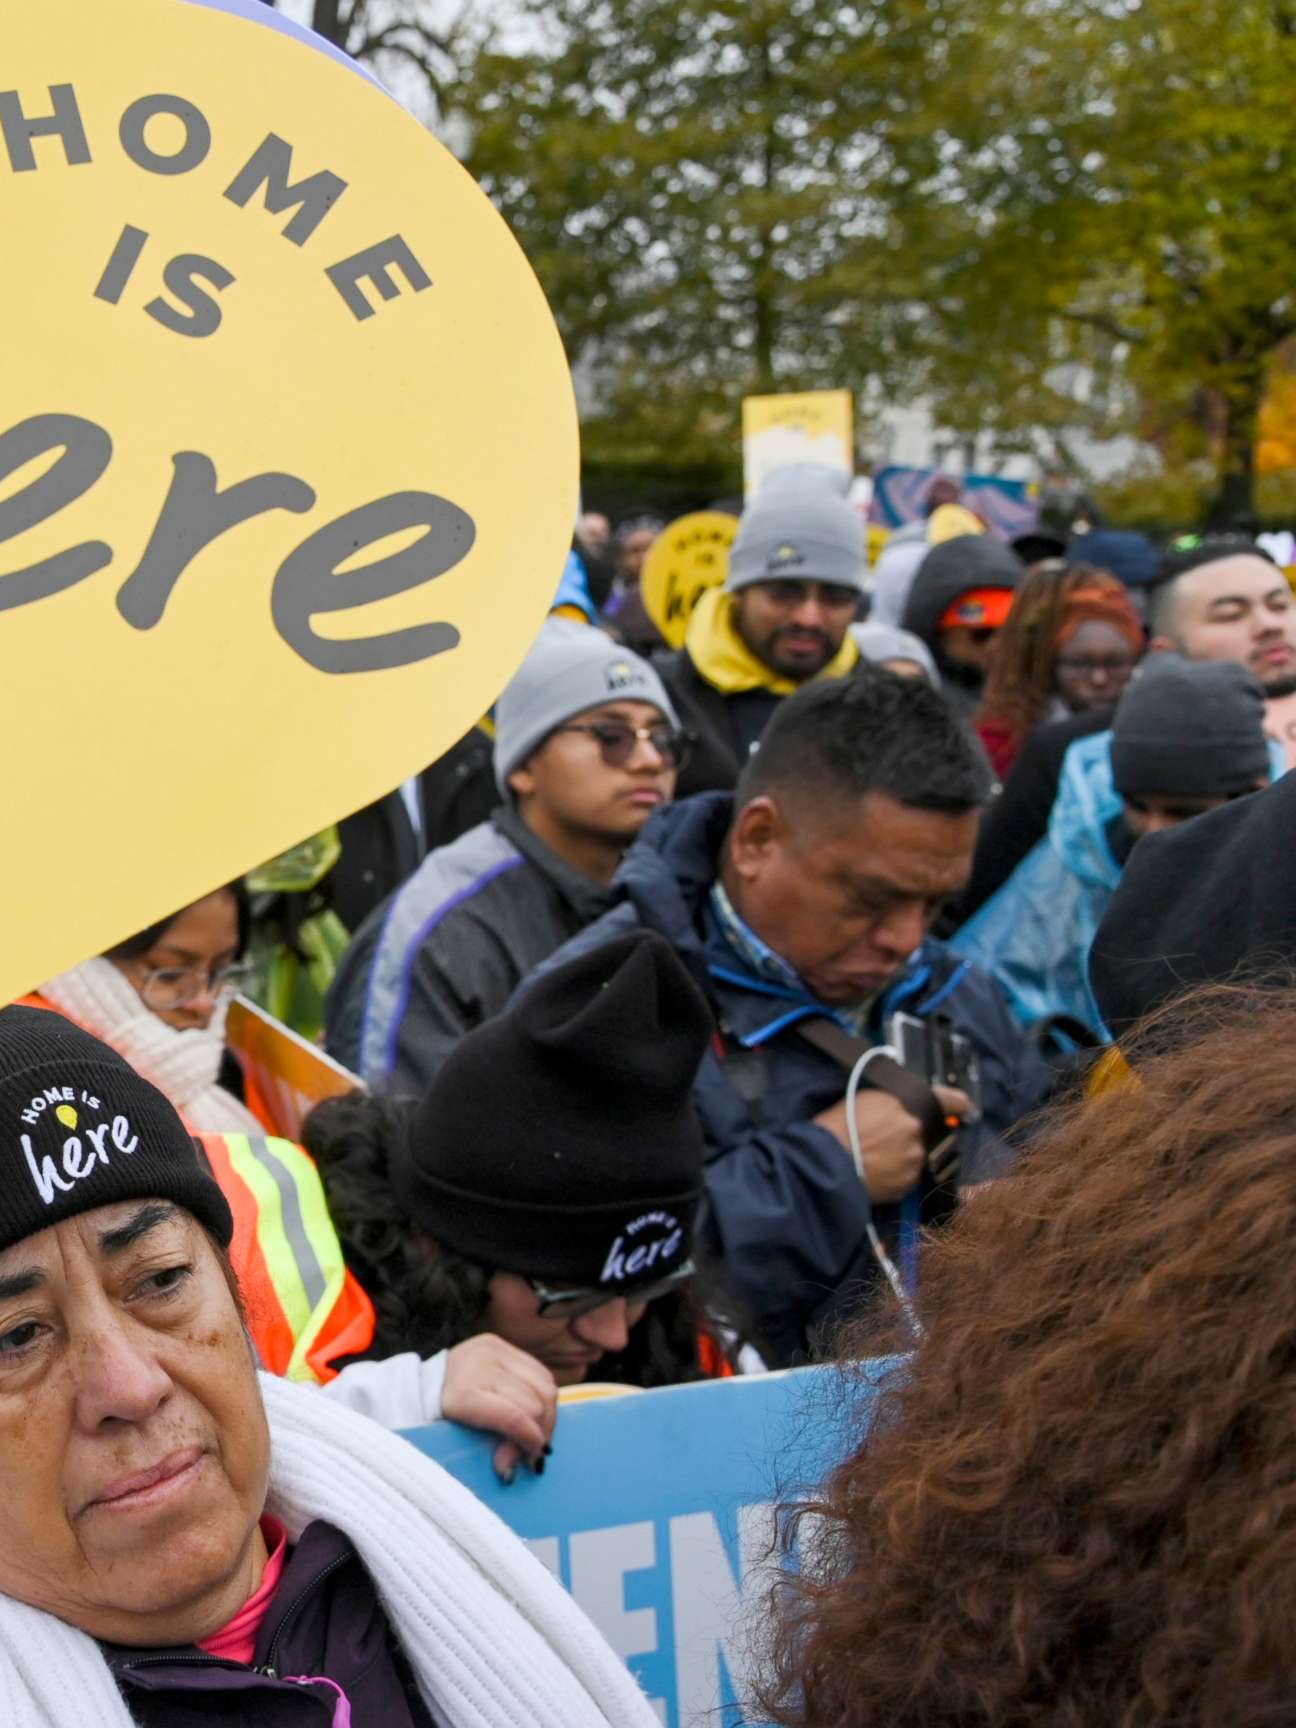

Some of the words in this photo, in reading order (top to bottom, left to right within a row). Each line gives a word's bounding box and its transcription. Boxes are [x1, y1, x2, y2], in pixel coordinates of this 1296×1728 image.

[94, 225, 236, 339] IS
[20, 1085, 75, 1126] HOME
[82, 1089, 101, 1110] IS
[19, 1114, 140, 1206] here
[599, 1228, 684, 1284] here
